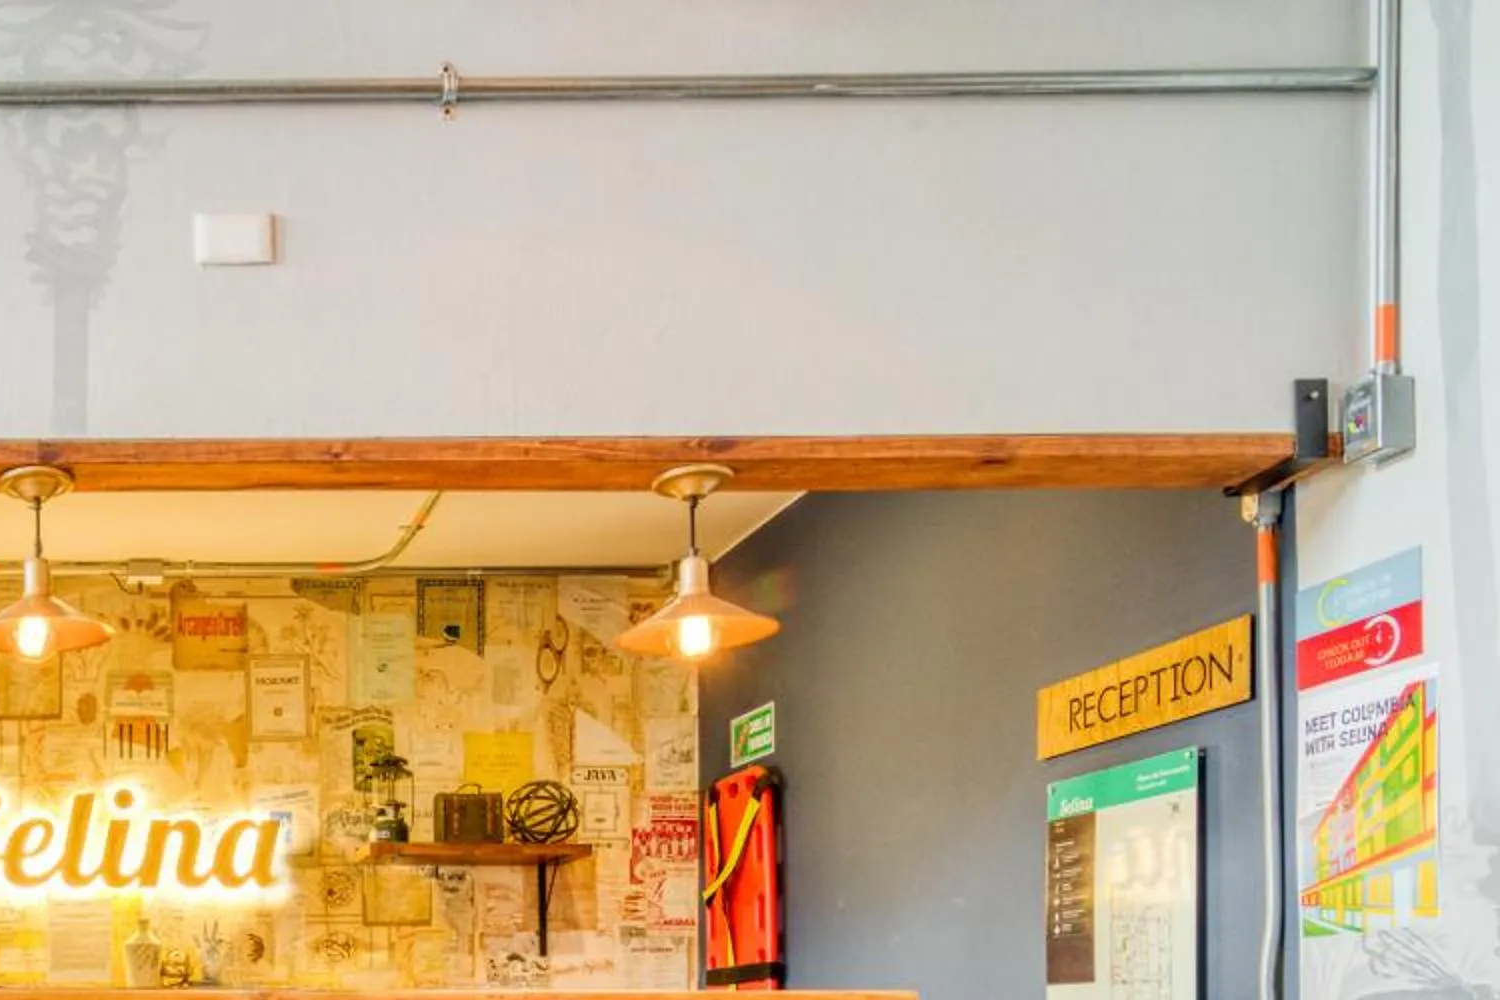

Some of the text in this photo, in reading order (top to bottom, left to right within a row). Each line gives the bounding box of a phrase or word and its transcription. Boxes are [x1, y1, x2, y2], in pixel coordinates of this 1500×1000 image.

[1069, 644, 1233, 733] RECEPTION
[1305, 693, 1416, 736] MEET COLOMBIA
[1305, 720, 1389, 757] WITH SELINA
[583, 769, 618, 781] JAVA
